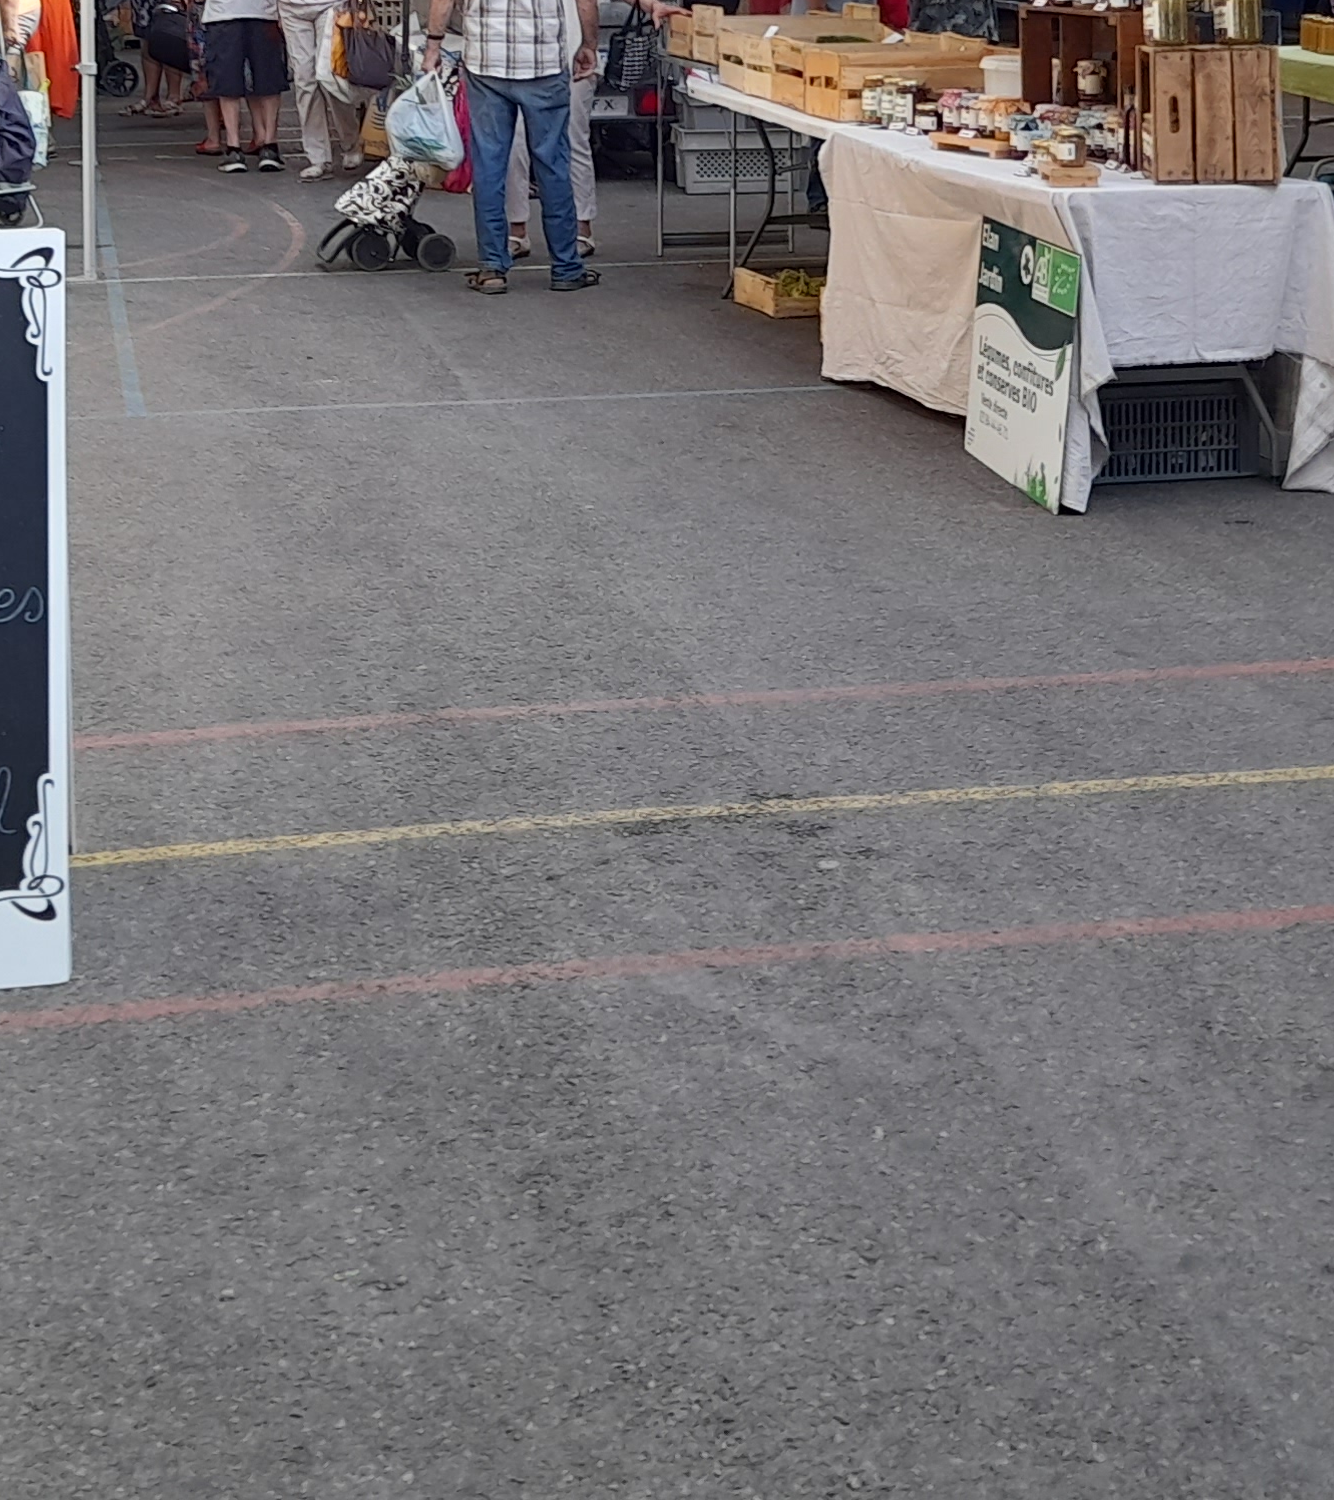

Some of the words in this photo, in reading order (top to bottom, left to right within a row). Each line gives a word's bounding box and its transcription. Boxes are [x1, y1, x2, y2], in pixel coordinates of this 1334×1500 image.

[979, 335, 1012, 377] Légumes,
[1013, 361, 1054, 397] confitures
[1022, 386, 1038, 413] BIO
